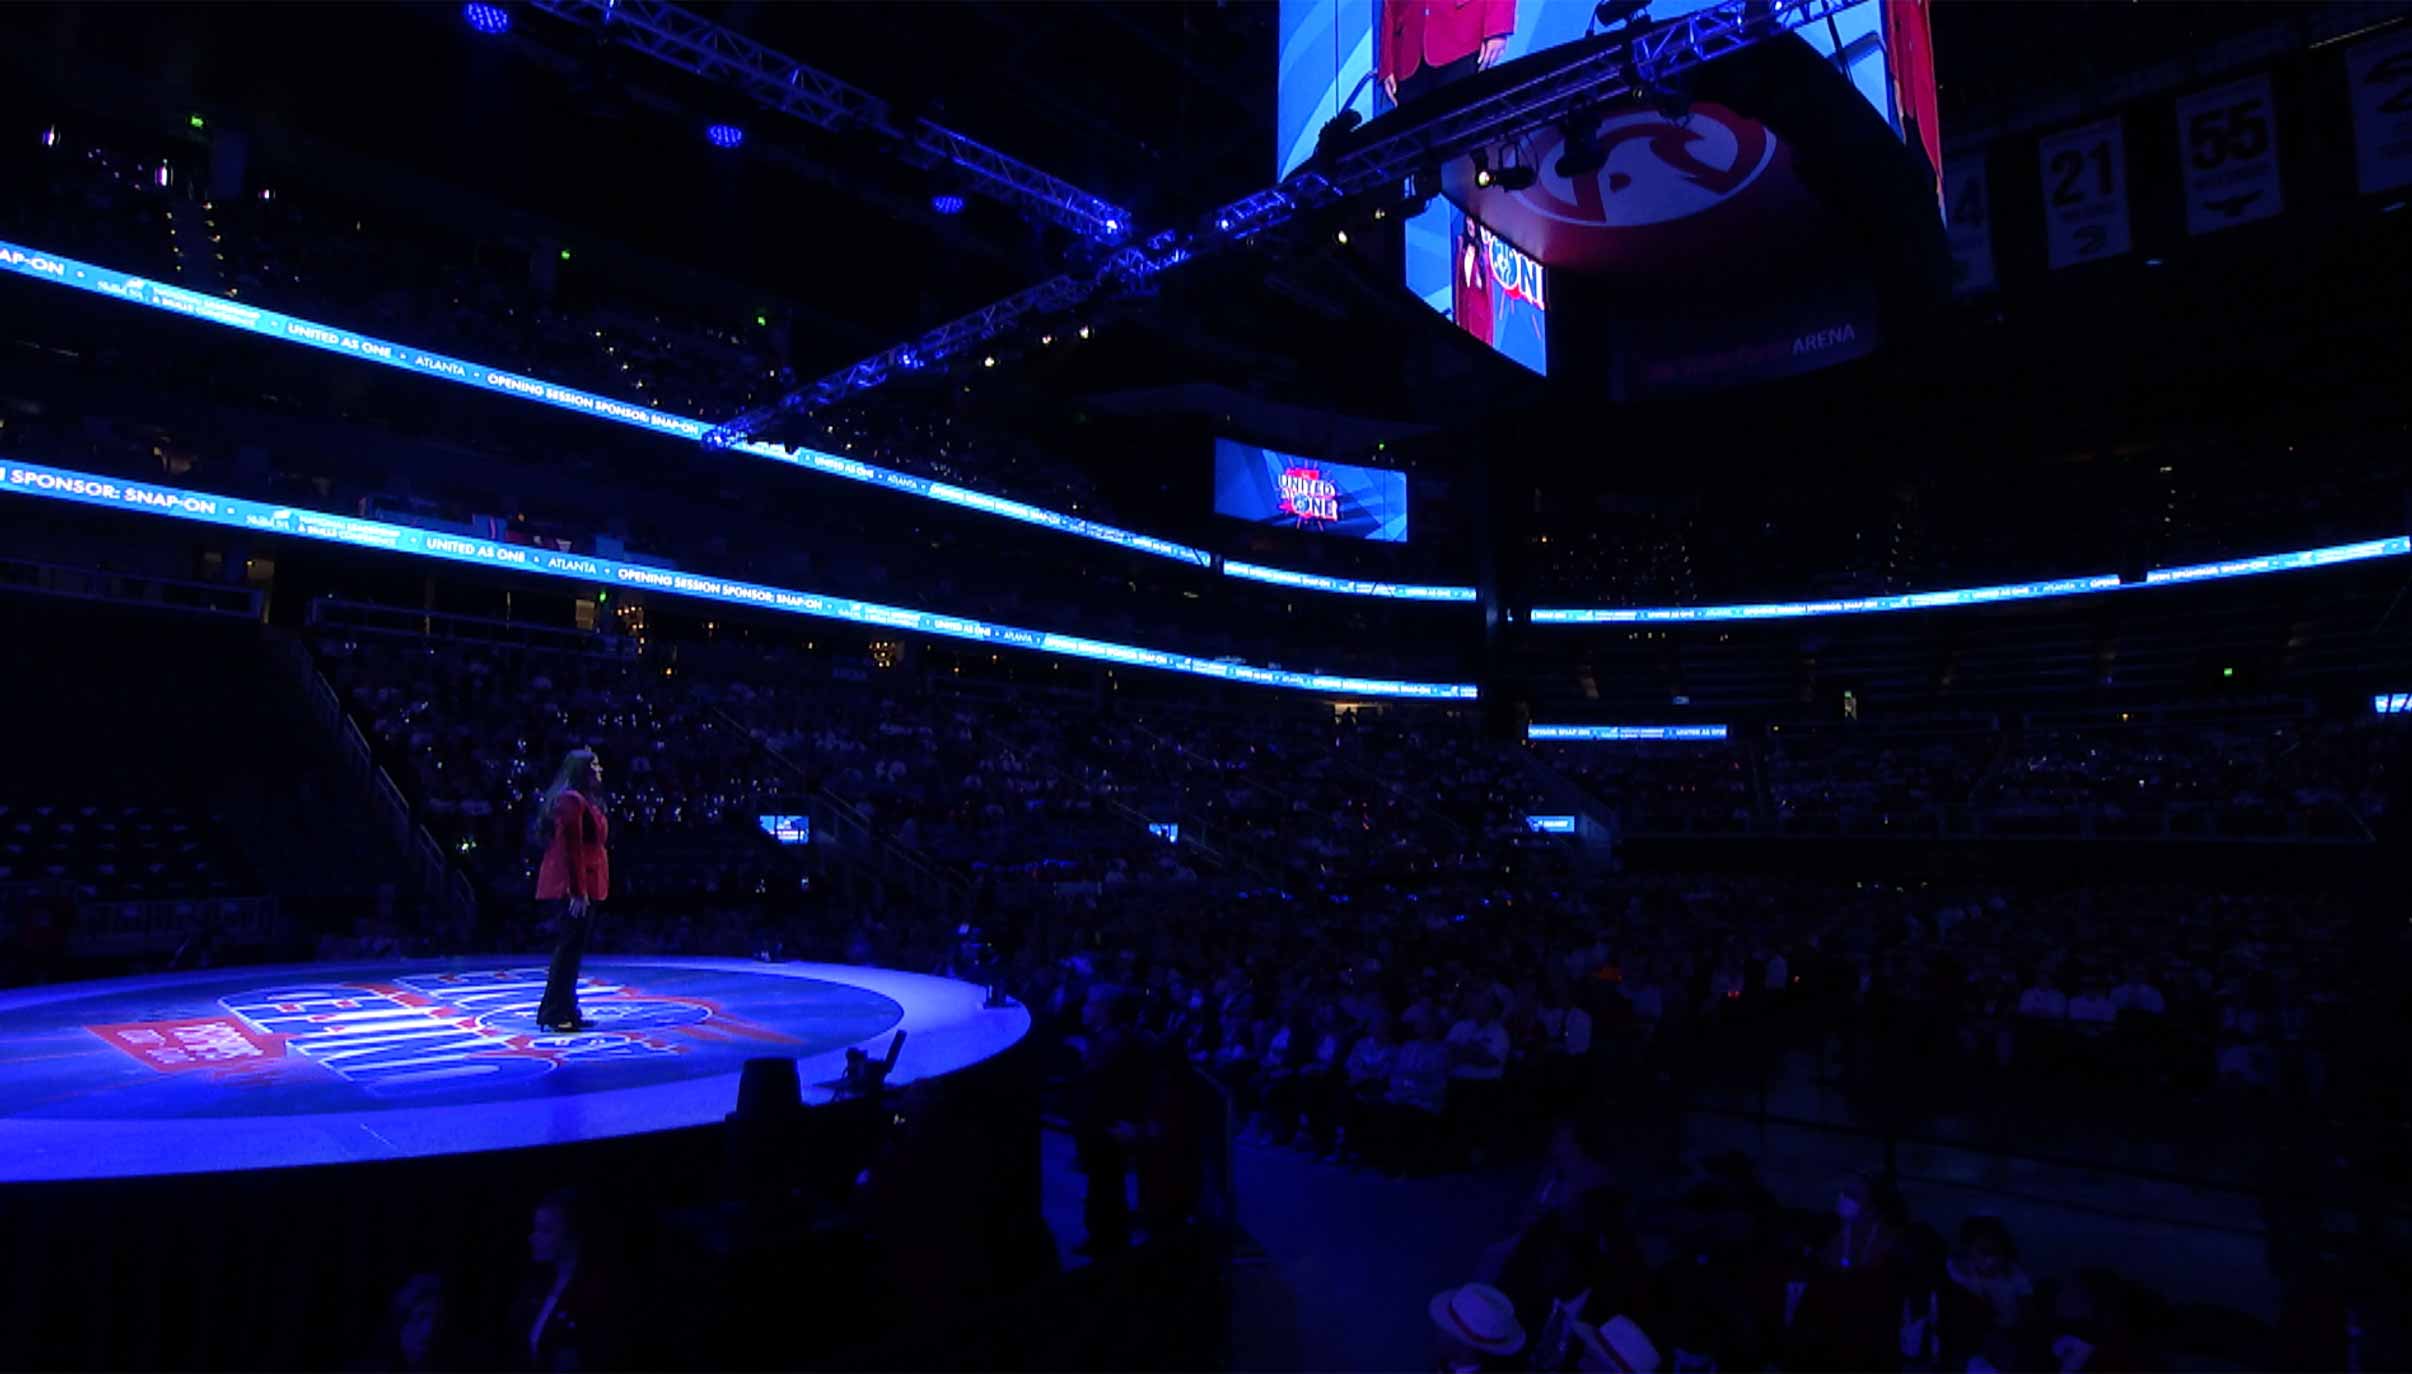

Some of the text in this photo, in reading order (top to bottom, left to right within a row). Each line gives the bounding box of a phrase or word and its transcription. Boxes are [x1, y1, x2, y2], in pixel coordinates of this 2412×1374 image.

[2051, 142, 2111, 206] 21
[287, 322, 392, 358] UNITED AS ONE
[1791, 322, 1857, 358] ARENA
[415, 356, 466, 377] ATLANTA
[487, 373, 699, 435] OPENING SESSION SPONSOR: SNAP-ON
[10, 468, 121, 499] SPONSOR:
[123, 487, 216, 514] SNAP-ON
[1278, 474, 1336, 498] UNITED
[426, 537, 526, 564] UNITED AS ONE
[548, 557, 597, 575] ATLANTA
[618, 568, 673, 587] OPENING
[674, 575, 721, 593] SESSION
[776, 593, 823, 611] SNAP-ON
